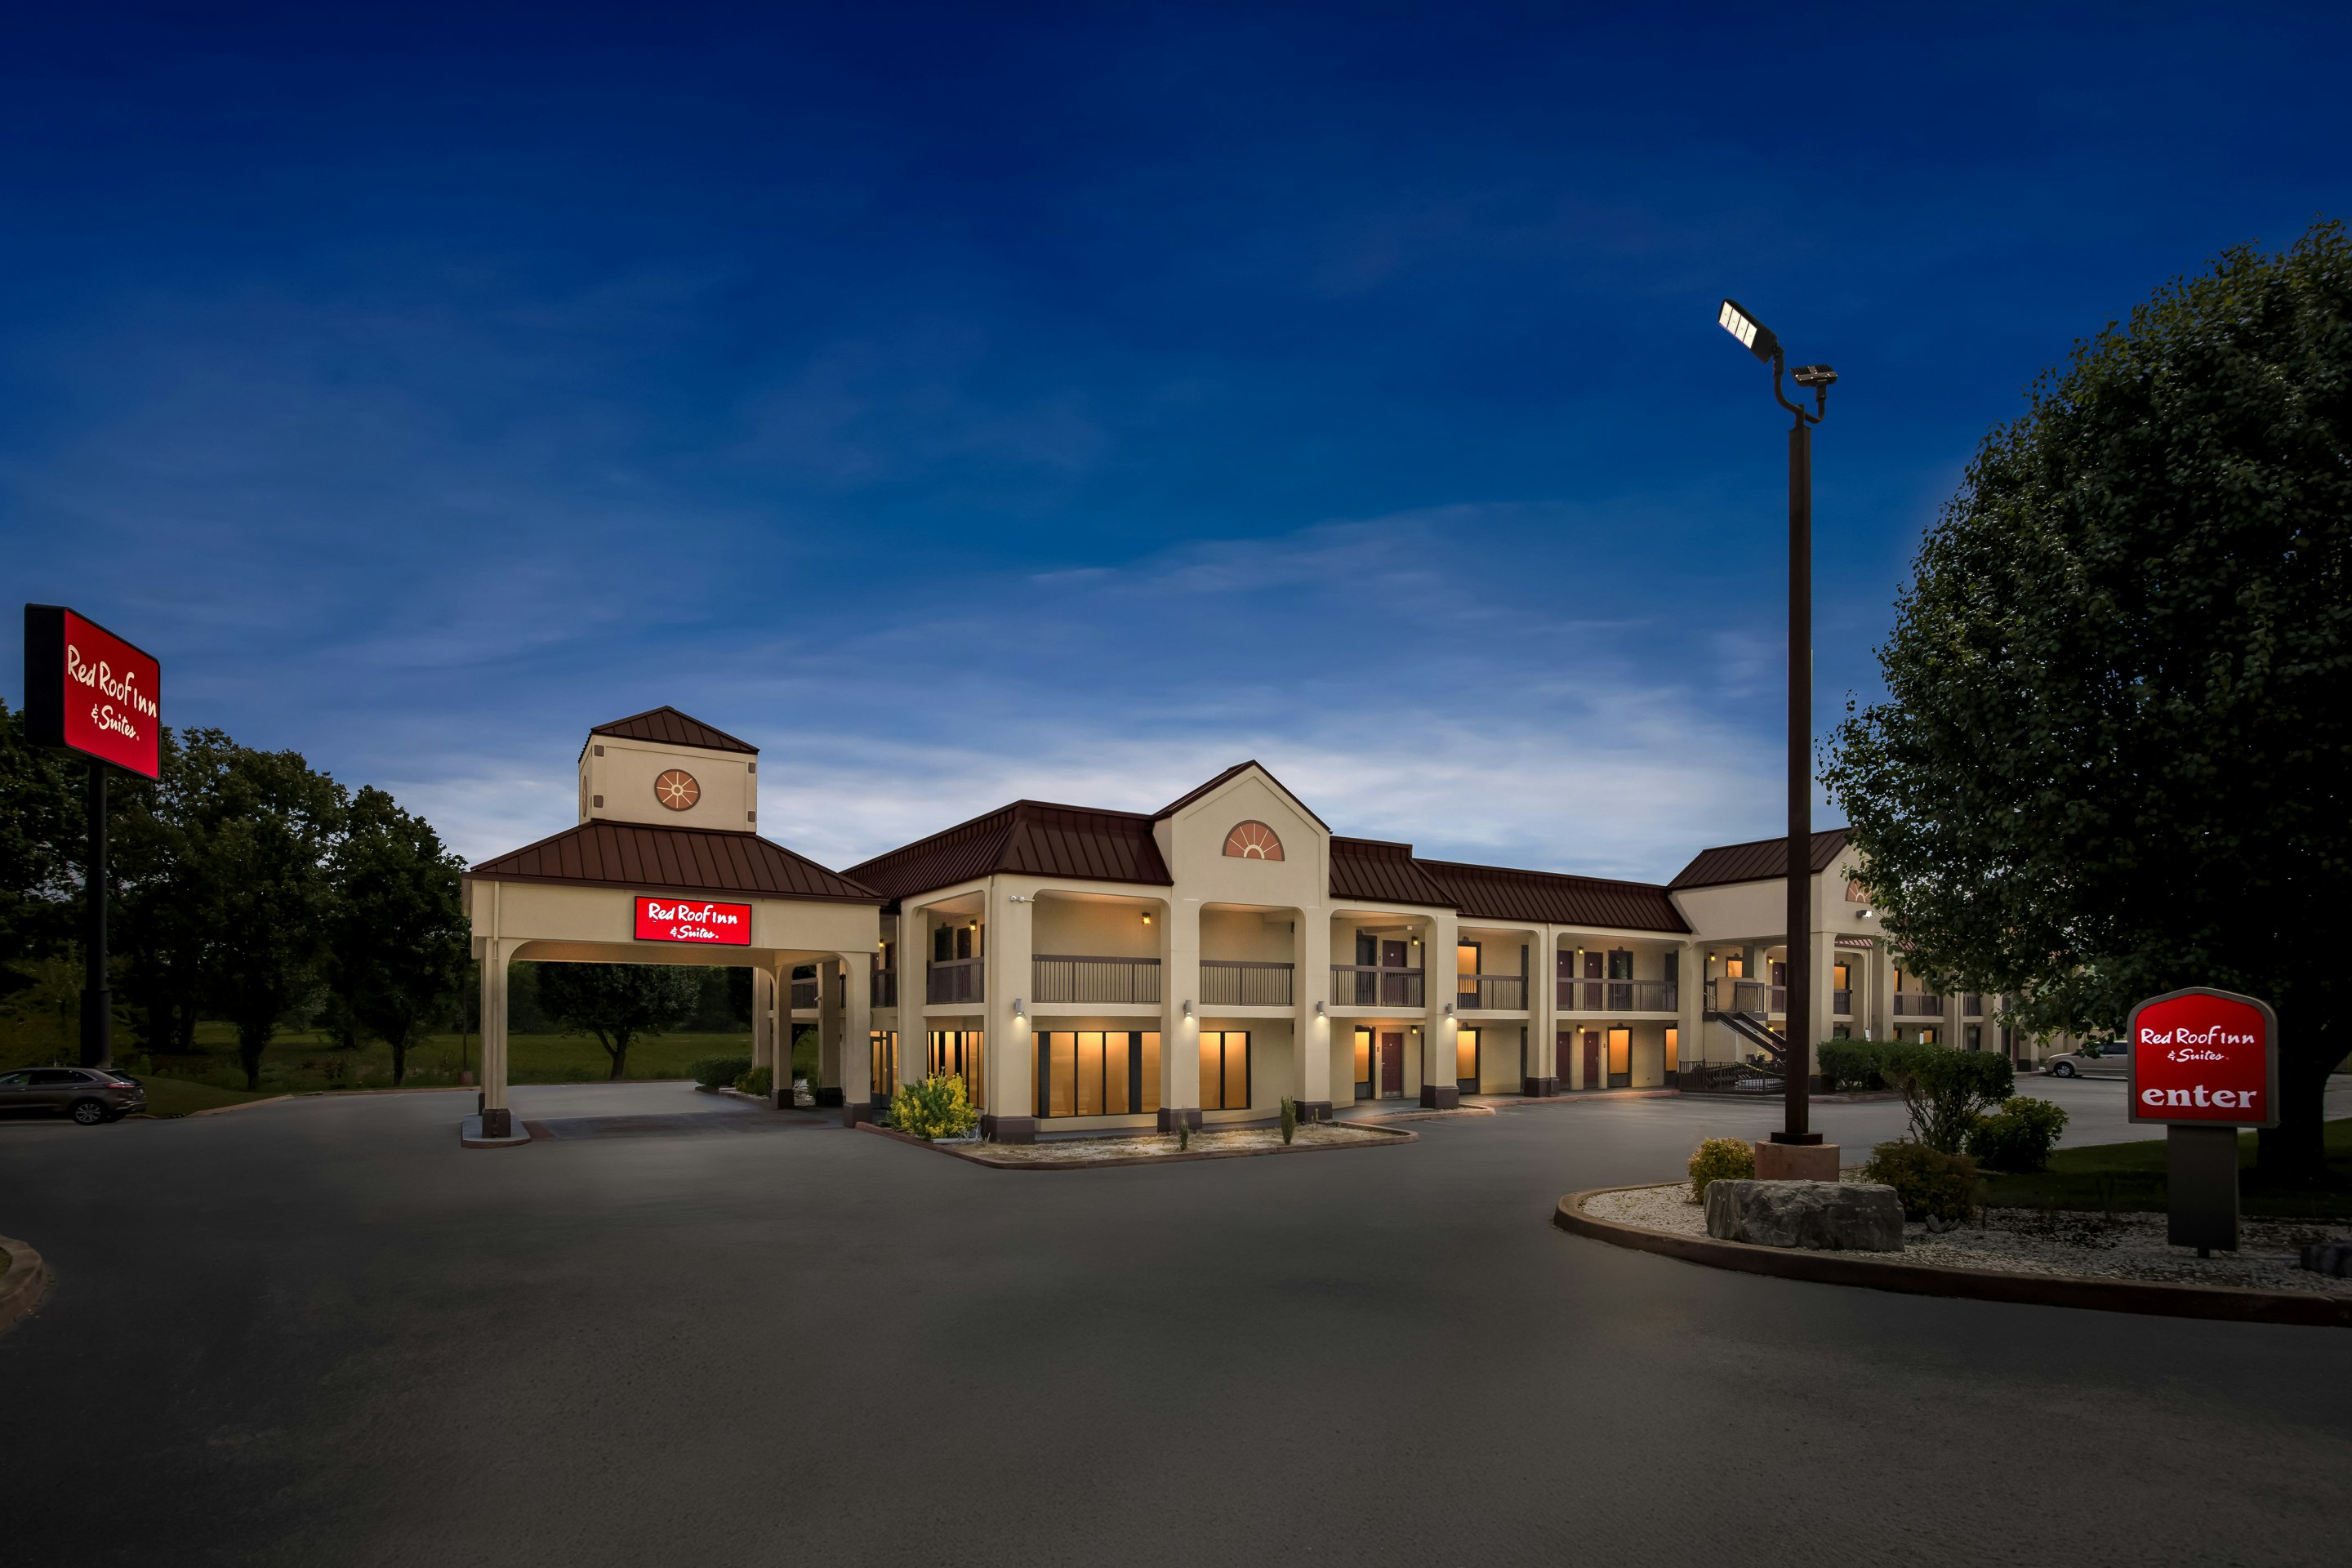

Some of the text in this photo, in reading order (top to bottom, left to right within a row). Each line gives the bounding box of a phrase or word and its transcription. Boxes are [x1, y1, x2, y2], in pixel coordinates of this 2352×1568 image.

[68, 644, 157, 719] Red Roof Inn
[91, 703, 99, 724] &
[648, 902, 737, 924] Red Roof Inn
[670, 926, 678, 937] &
[2140, 1025, 2255, 1045] Red Roof Inn
[2167, 1050, 2176, 1061] &
[2141, 1085, 2257, 1108] enter
